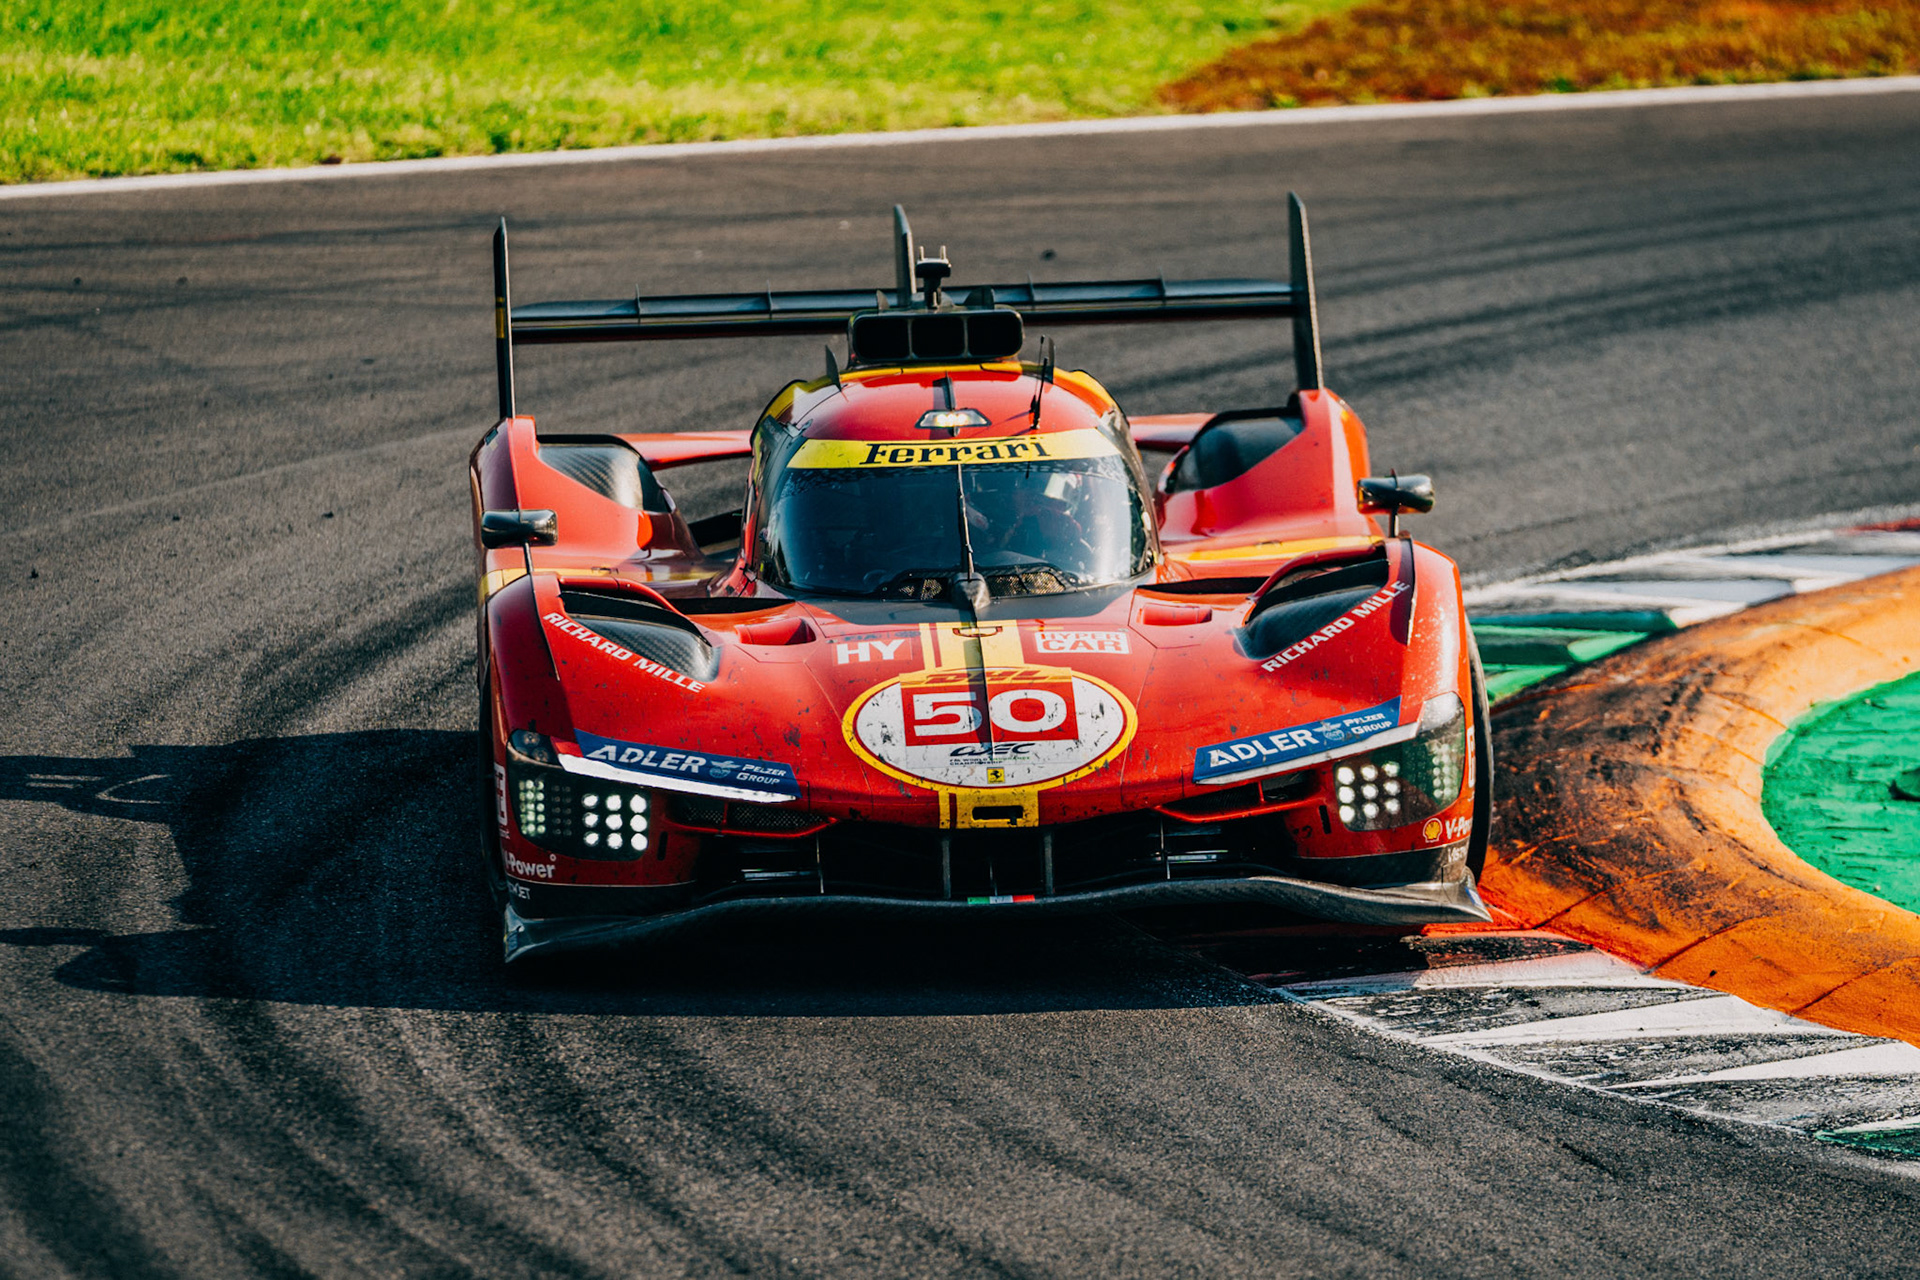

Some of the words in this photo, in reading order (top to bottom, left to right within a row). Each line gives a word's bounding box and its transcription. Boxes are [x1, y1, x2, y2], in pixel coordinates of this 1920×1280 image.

[859, 437, 1051, 466] Ferrari
[1261, 617, 1355, 673] RICHARD
[1351, 580, 1410, 618] MILLE
[543, 612, 633, 661] RICHARD
[633, 658, 705, 693] MILLE
[836, 639, 905, 665] HY
[1042, 640, 1122, 651] CAR
[925, 670, 1049, 684] DHL
[912, 689, 1067, 736] 50
[586, 744, 707, 773] ADLER
[950, 743, 1036, 756] WEC
[1209, 729, 1320, 768] ADLER
